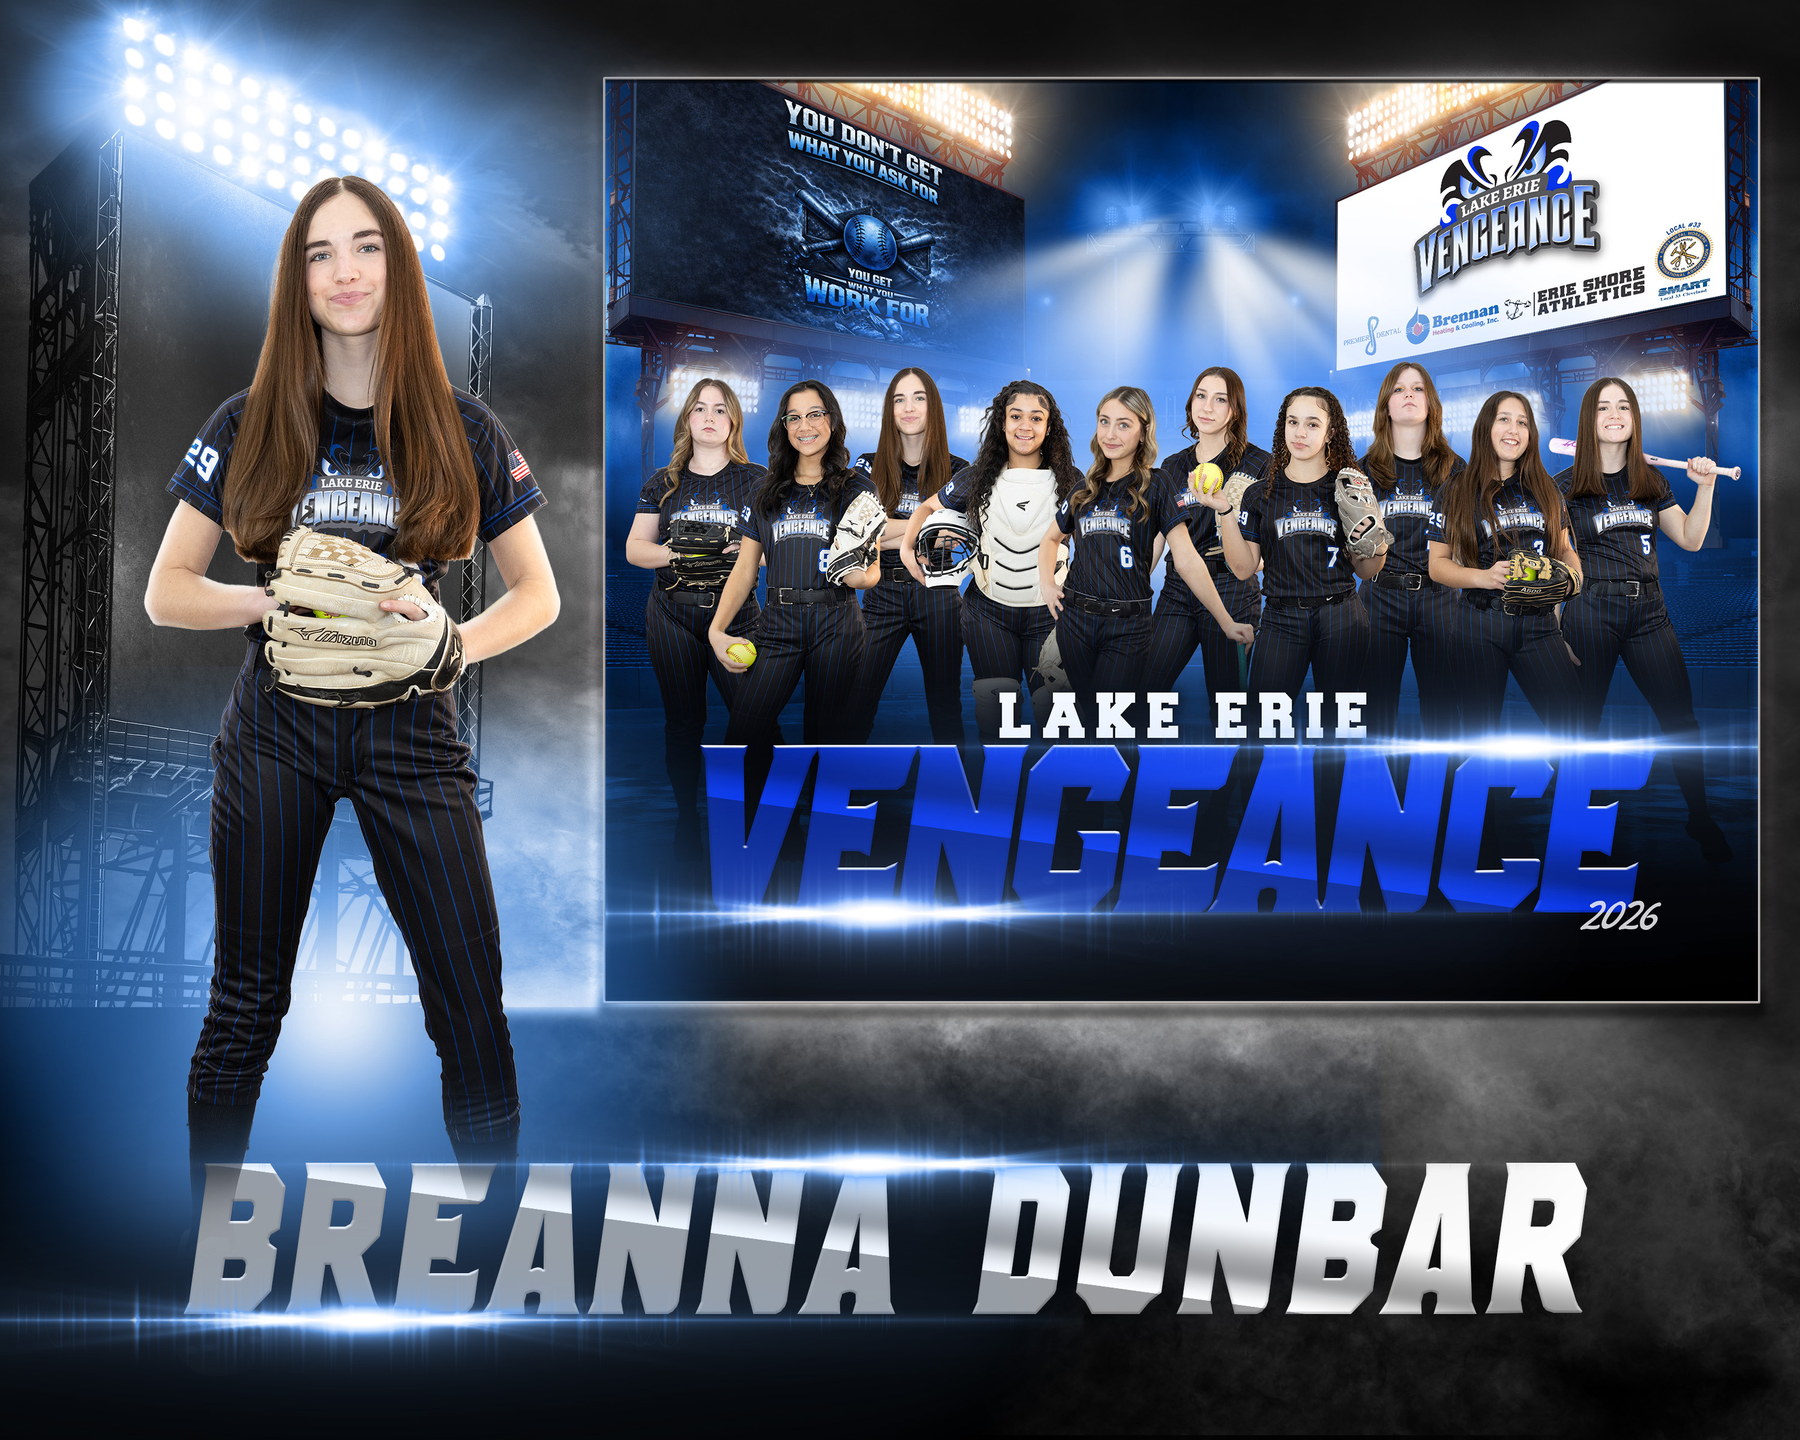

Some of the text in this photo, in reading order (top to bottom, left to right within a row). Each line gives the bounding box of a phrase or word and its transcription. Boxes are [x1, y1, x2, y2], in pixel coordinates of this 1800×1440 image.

[784, 99, 943, 186] YOU DON'T GET
[787, 129, 939, 206] WHAT YOU ASK FOR
[1461, 178, 1541, 218] LAKE ERIE
[1416, 184, 1597, 294] VENGEANCE
[1665, 223, 1686, 236] LOCAL
[848, 267, 893, 288] YOU GET
[1537, 266, 1645, 303] ERIE SHORE
[1657, 278, 1711, 297] SMART
[804, 273, 930, 328] WORK FOR
[848, 281, 894, 298] WHAT YOU
[1537, 280, 1645, 316] ATHLETICS
[1432, 304, 1500, 328] Brennan
[1432, 327, 1455, 336] Heating
[1461, 319, 1486, 331] Cooling,
[1487, 315, 1500, 325] Inc.
[1343, 328, 1402, 346] PREMIER DENTAL
[184, 437, 220, 483] 29
[321, 478, 383, 492] LAKE ERIE
[1079, 517, 1131, 538] VENGEANCE
[1275, 517, 1337, 539] VENGEANCE
[1429, 512, 1443, 528] 29
[772, 520, 831, 543] VENGEANCE
[1640, 534, 1650, 554] 5
[1120, 546, 1133, 568] 6
[1327, 546, 1340, 568] 7
[315, 630, 377, 648] MIZUNO
